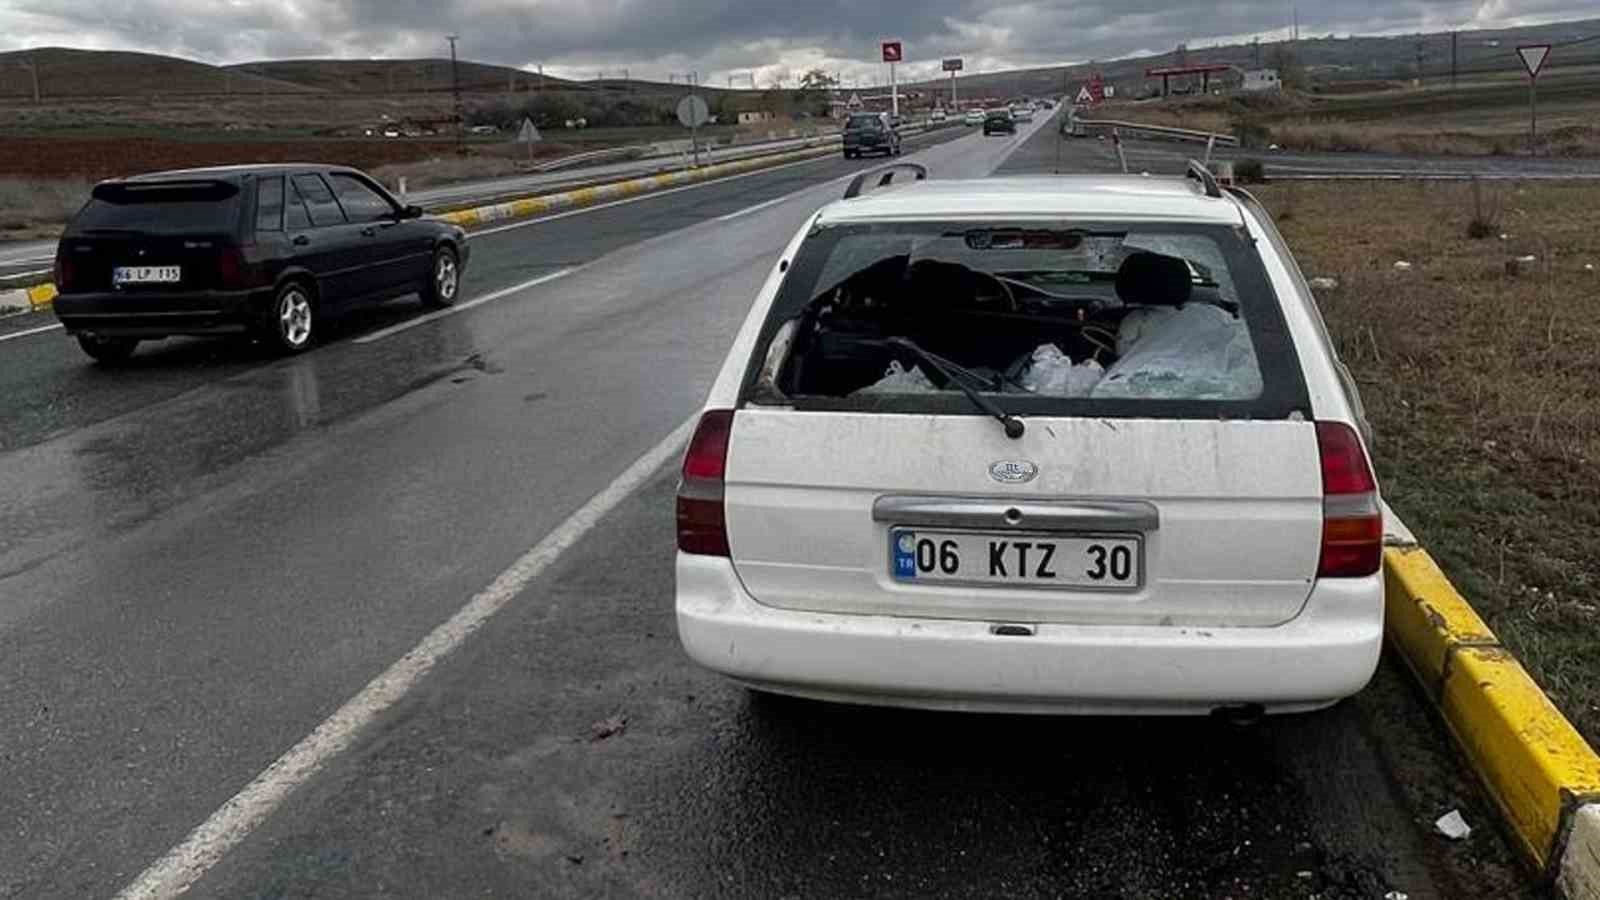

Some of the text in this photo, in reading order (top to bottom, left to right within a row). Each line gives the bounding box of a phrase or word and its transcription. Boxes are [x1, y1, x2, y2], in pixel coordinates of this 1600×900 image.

[899, 558, 914, 569] TR
[916, 538, 1131, 580] 06 KTZ 30
